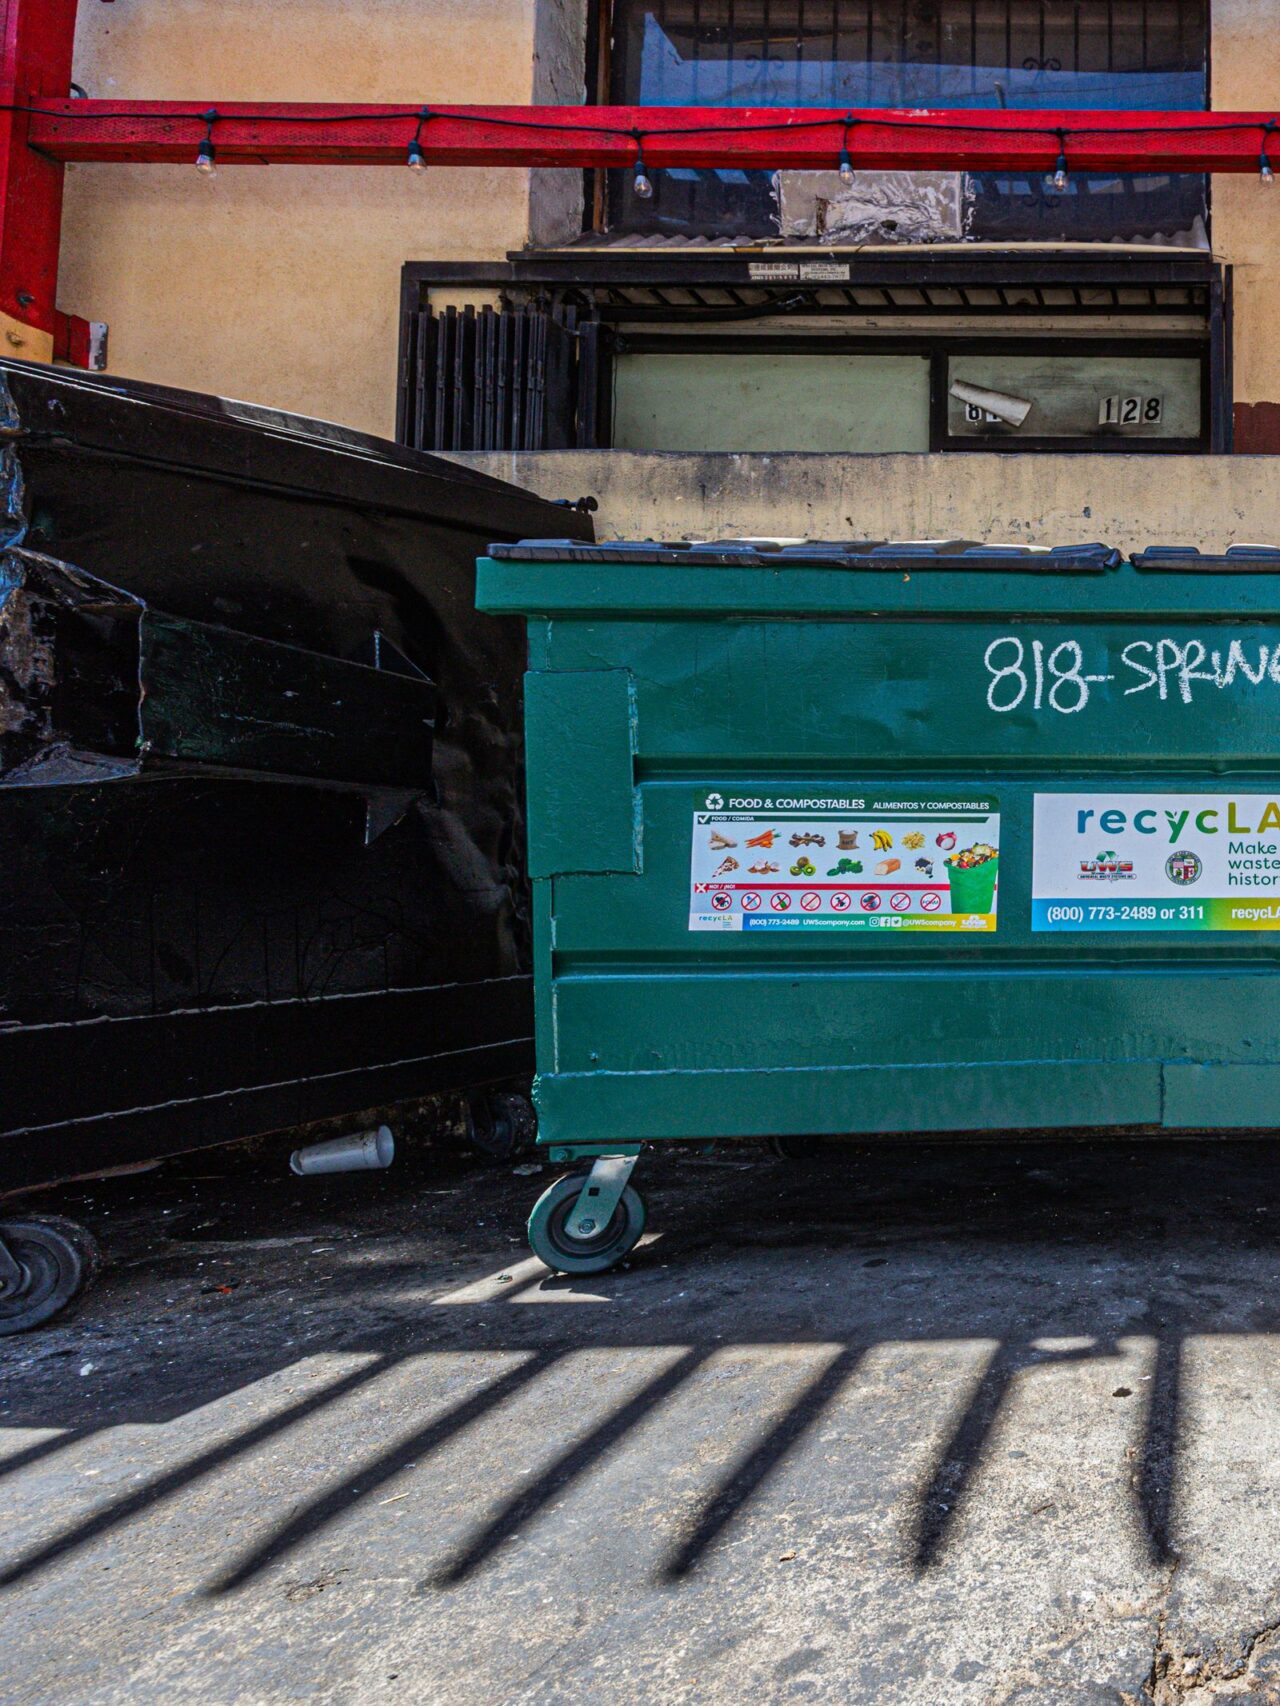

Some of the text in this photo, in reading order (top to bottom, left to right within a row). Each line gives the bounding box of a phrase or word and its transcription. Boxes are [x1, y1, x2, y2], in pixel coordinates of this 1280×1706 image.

[1105, 398, 1160, 422] 128
[729, 799, 865, 809] FOOD & COMPOSTABLES
[927, 802, 989, 810] COMPOSTABLES
[1228, 841, 1278, 854] Make
[1080, 860, 1133, 872] UWS
[1228, 857, 1280, 870] waste
[1047, 906, 1204, 922] (800) 773-2489 or 311
[749, 918, 767, 926] (800)
[768, 918, 799, 926] 773-2489
[803, 918, 865, 927] UWScompany.com
